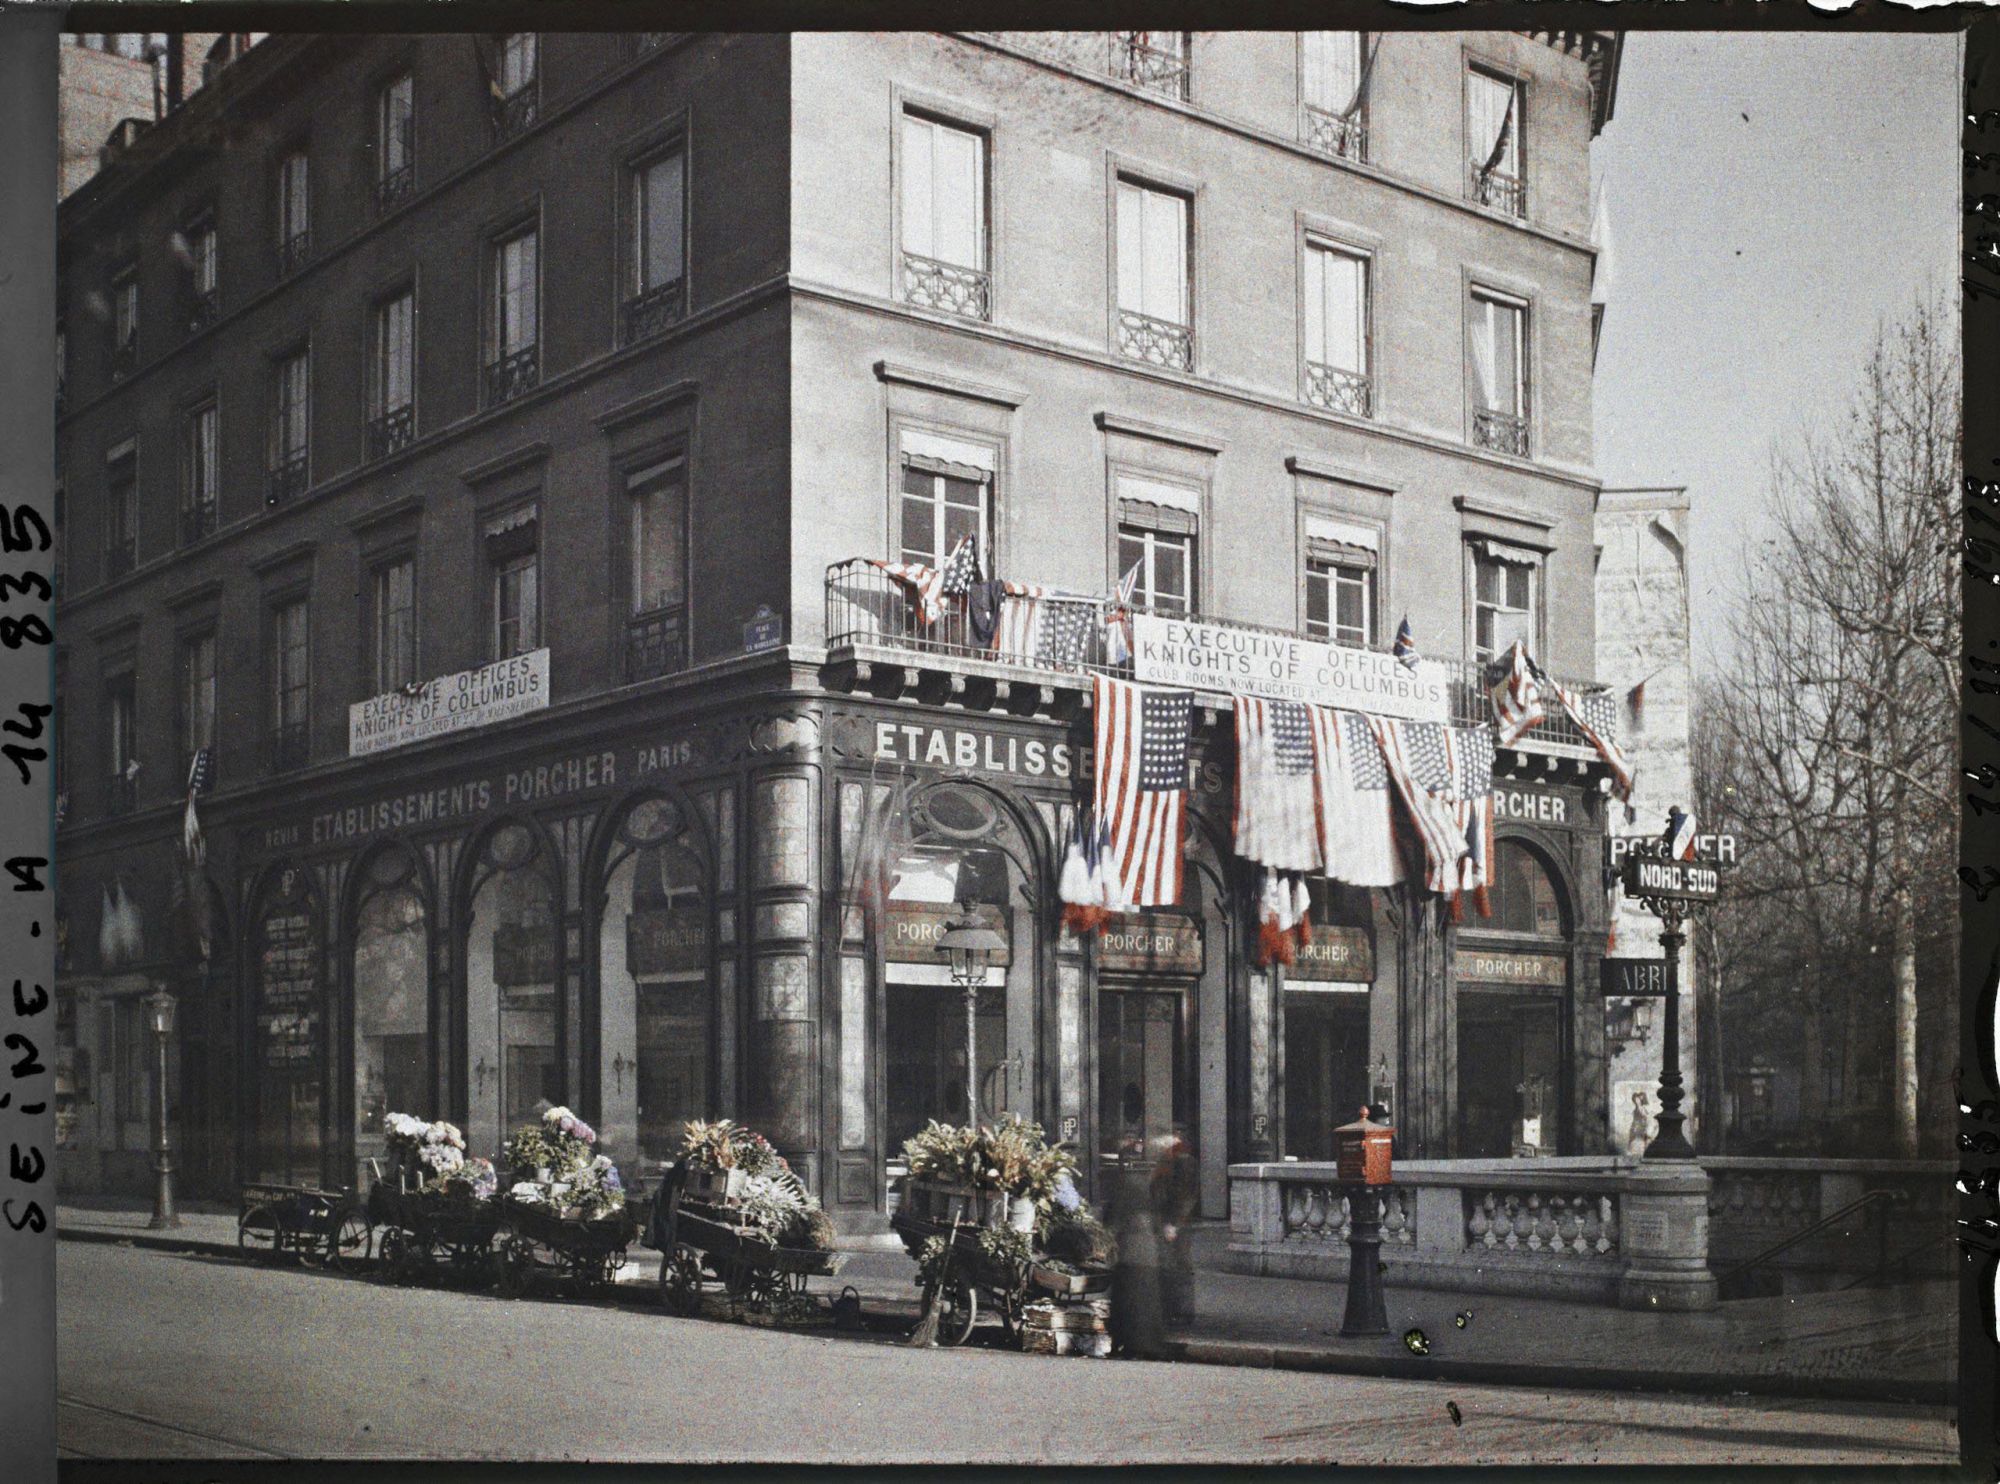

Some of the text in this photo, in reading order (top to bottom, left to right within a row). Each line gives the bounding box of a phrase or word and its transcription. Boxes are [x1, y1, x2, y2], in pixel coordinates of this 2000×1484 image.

[1167, 623, 1418, 681] EXECUTIVE OFFICES
[458, 657, 530, 692] OFFICES
[1143, 641, 1440, 703] KNIGHTS OF COLUMBUS
[1148, 666, 1179, 681] CLUB
[1185, 671, 1224, 687] ROOMS
[1230, 677, 1255, 691] NOW
[1258, 682, 1304, 698] LOCATED
[355, 674, 539, 738] KNIGHTS OF COLUMBUS
[418, 719, 449, 737] LOCATED
[876, 722, 1223, 794] ETABLISSETS
[312, 780, 491, 844] ETABLISSEMENTS
[505, 750, 617, 801] PORCHER
[638, 740, 692, 772] PARIS
[1493, 790, 1565, 822] RCHER
[1640, 863, 1718, 893] NORD-SUD
[1104, 933, 1175, 952] PORCHER
[1476, 958, 1542, 977] PORCHER
[1621, 965, 1667, 991] ABRI
